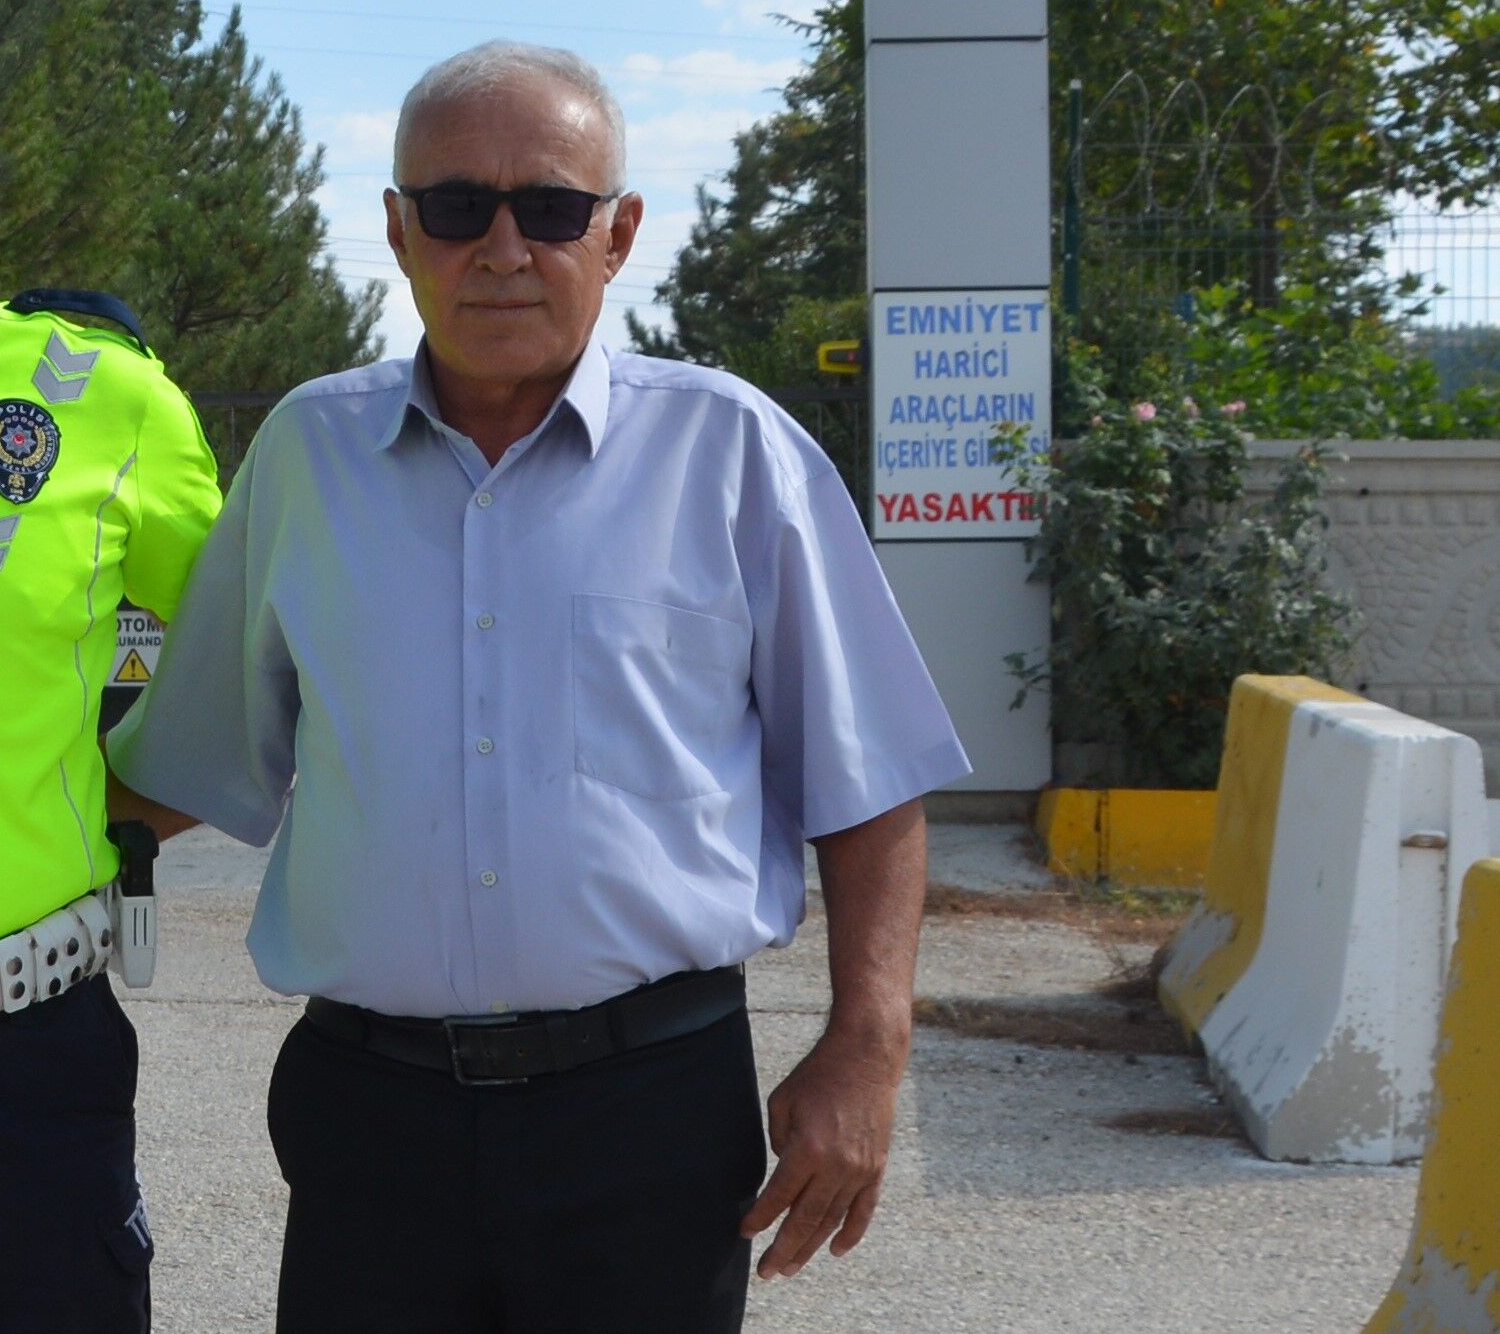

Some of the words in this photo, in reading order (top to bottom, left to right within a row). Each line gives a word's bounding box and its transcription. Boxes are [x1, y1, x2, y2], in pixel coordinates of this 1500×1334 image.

[886, 297, 1046, 336] EMNİYET
[914, 341, 1009, 379] HARİCİ
[889, 392, 1035, 432] ARAÇLARIN
[878, 432, 958, 476] İÇERİYE
